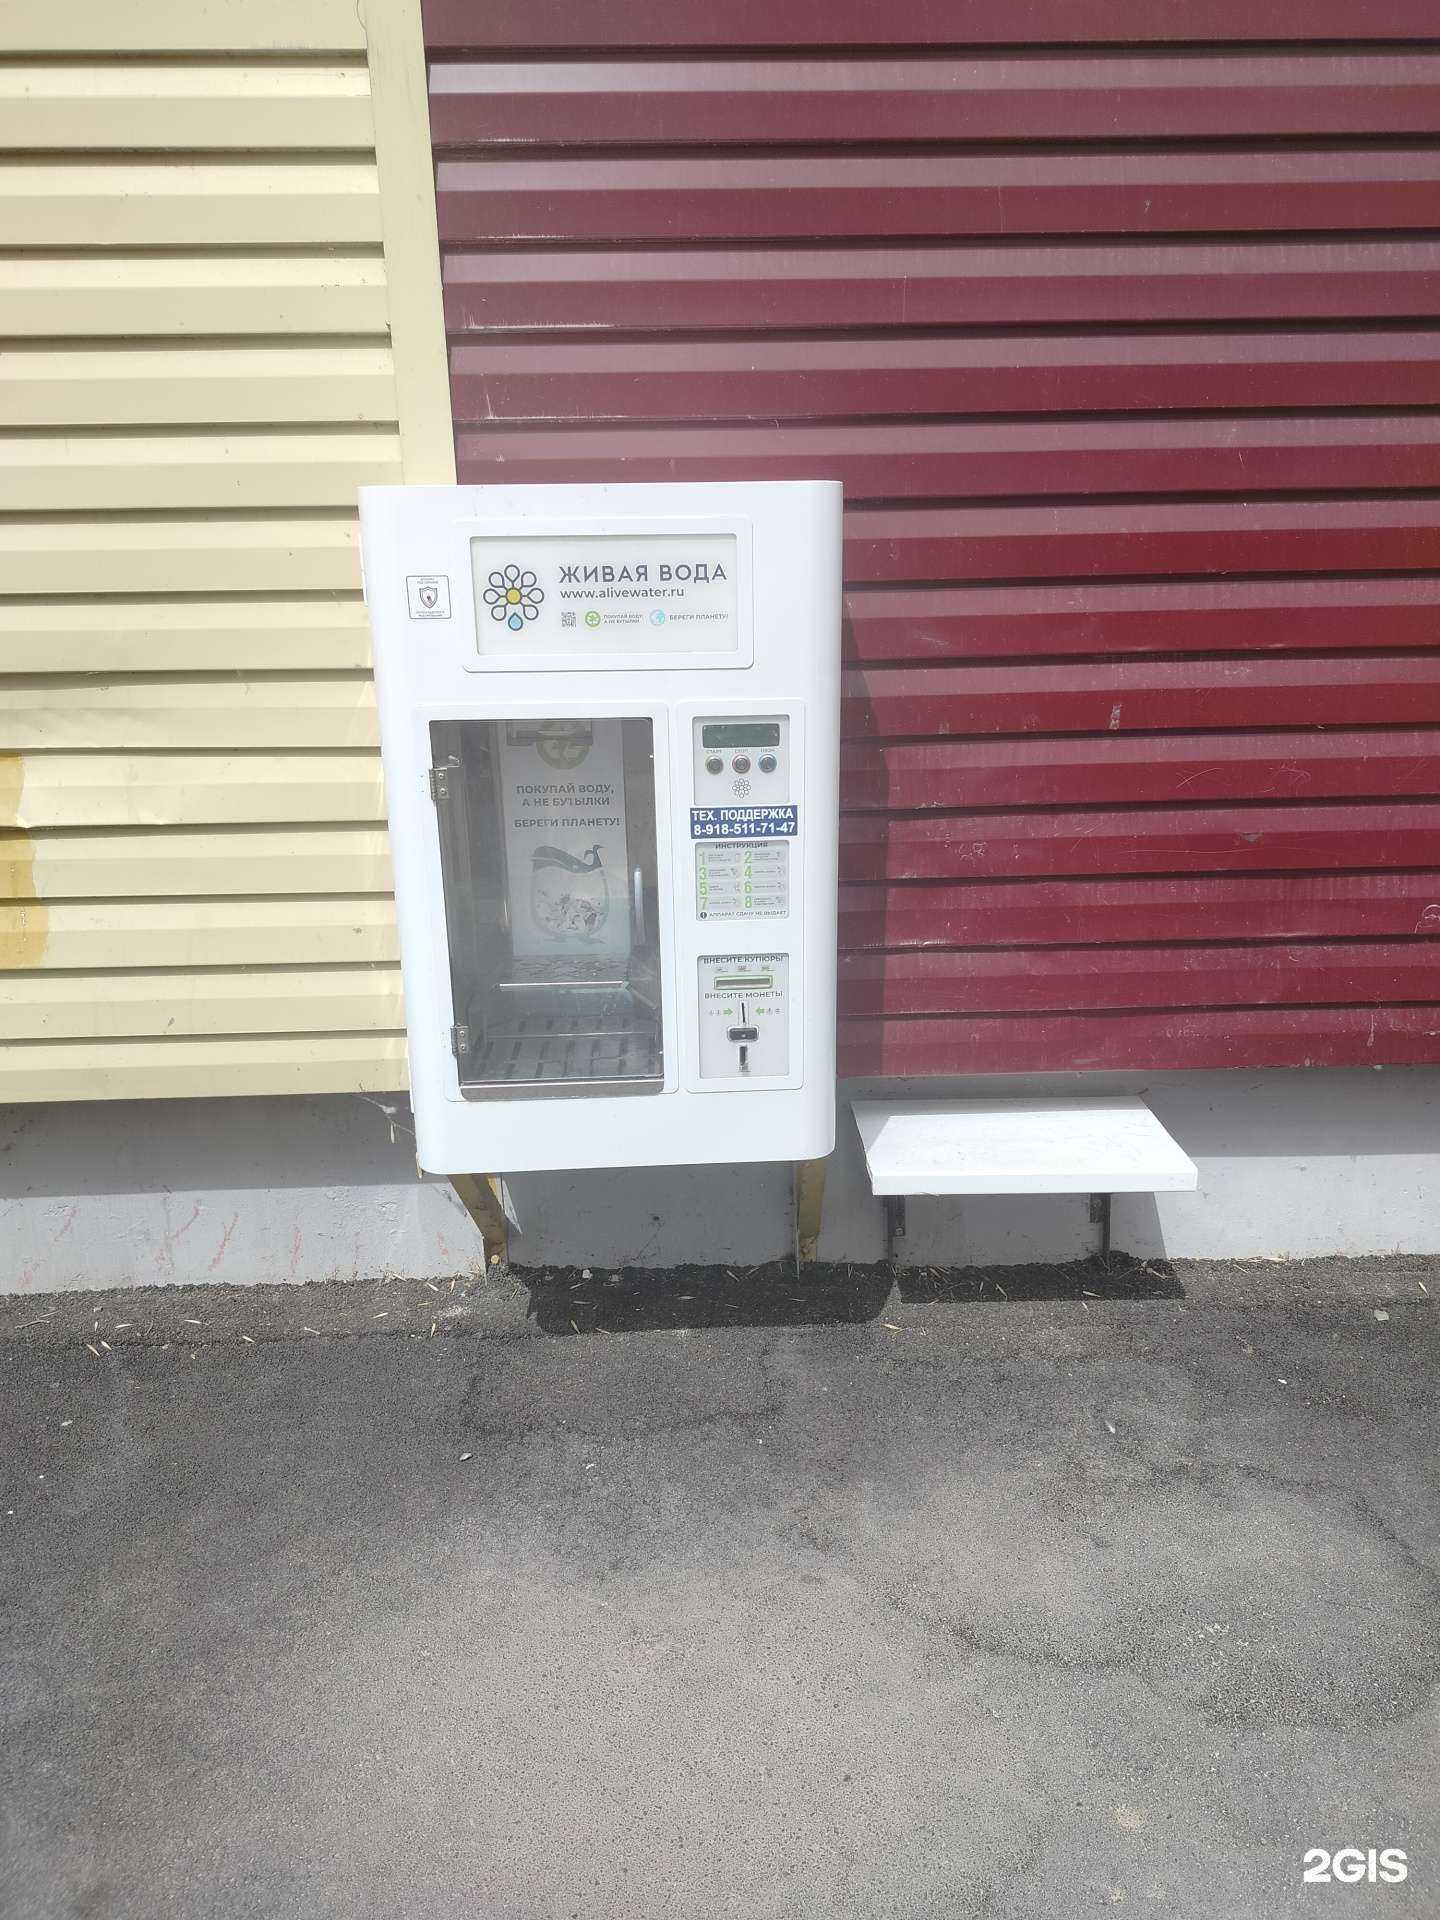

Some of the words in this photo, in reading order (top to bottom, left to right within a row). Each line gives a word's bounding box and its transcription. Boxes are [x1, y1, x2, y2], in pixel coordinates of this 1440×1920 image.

[559, 565, 648, 583] ЖИВАЯ
[659, 563, 727, 583] ВОДА
[560, 586, 685, 599] www.alivewater.ru
[516, 783, 575, 794] ПОКУПАЙ
[578, 784, 615, 795] ВОДУ,
[522, 798, 530, 807] А
[534, 798, 549, 807] НЕ
[552, 797, 610, 807] БУТЫЛКИ
[691, 811, 717, 821] ТЕХ.
[720, 808, 794, 822] ПОДДЕРЖКА
[514, 819, 558, 828] БЕРЕГИ
[562, 817, 620, 827] ПЛАНЕТУ!
[694, 822, 796, 836] 8-918-511-71-47
[715, 841, 769, 849] ИНСТРУКЦИЯ
[703, 956, 743, 964] ВНЕСИТЕ
[744, 955, 783, 963] КУПЮРЫ
[704, 992, 744, 1000] ВНЕСИТЕ
[745, 991, 783, 999] МОНЕТЫ
